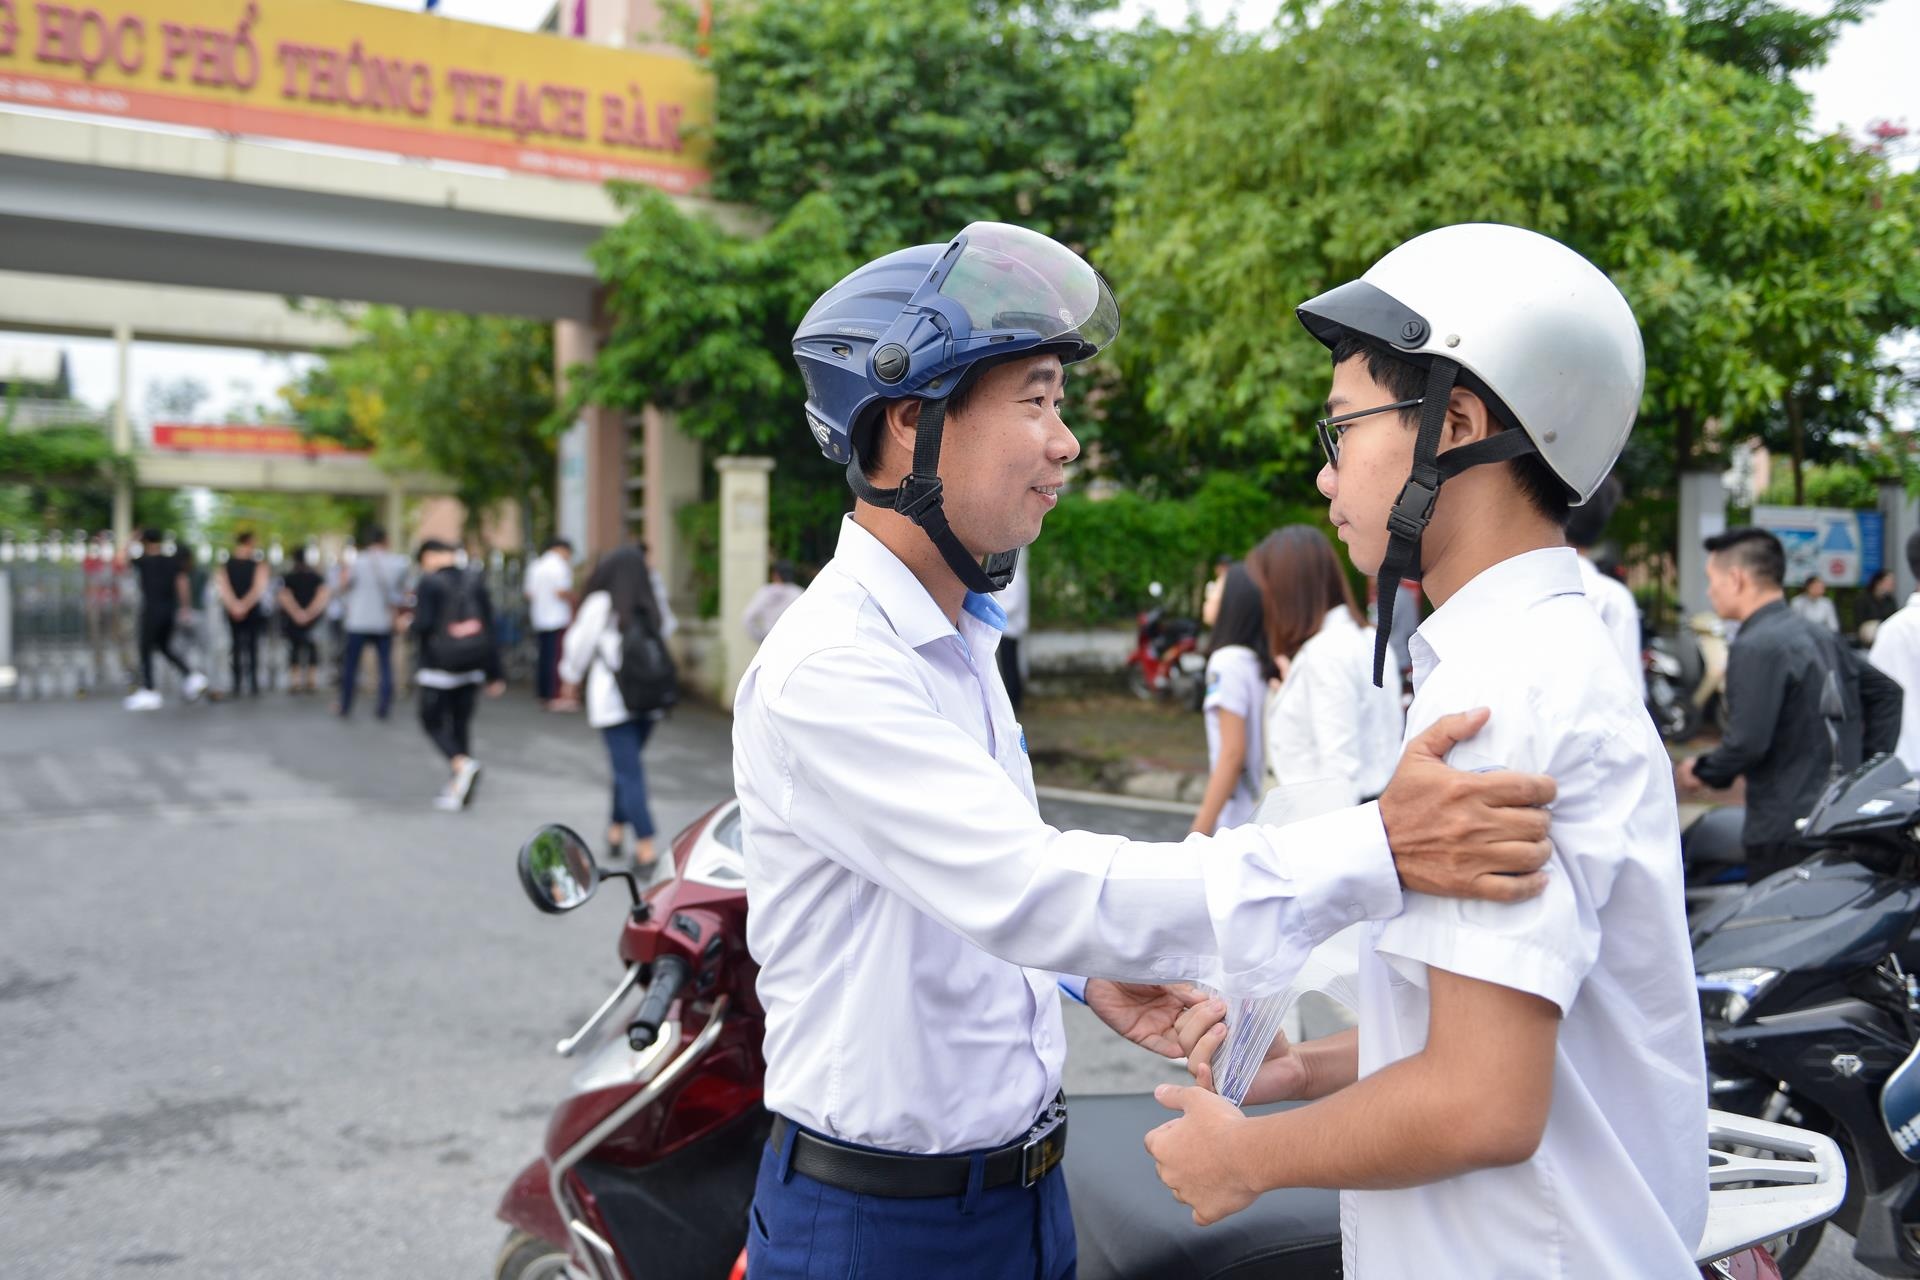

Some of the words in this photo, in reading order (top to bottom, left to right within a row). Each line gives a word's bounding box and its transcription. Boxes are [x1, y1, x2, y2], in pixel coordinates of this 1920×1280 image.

[35, 3, 146, 79] HỌC
[159, 0, 259, 90] PHỔ
[276, 38, 433, 118] THÔNG
[447, 68, 588, 142] THẠCH
[601, 81, 684, 156] BÀN
